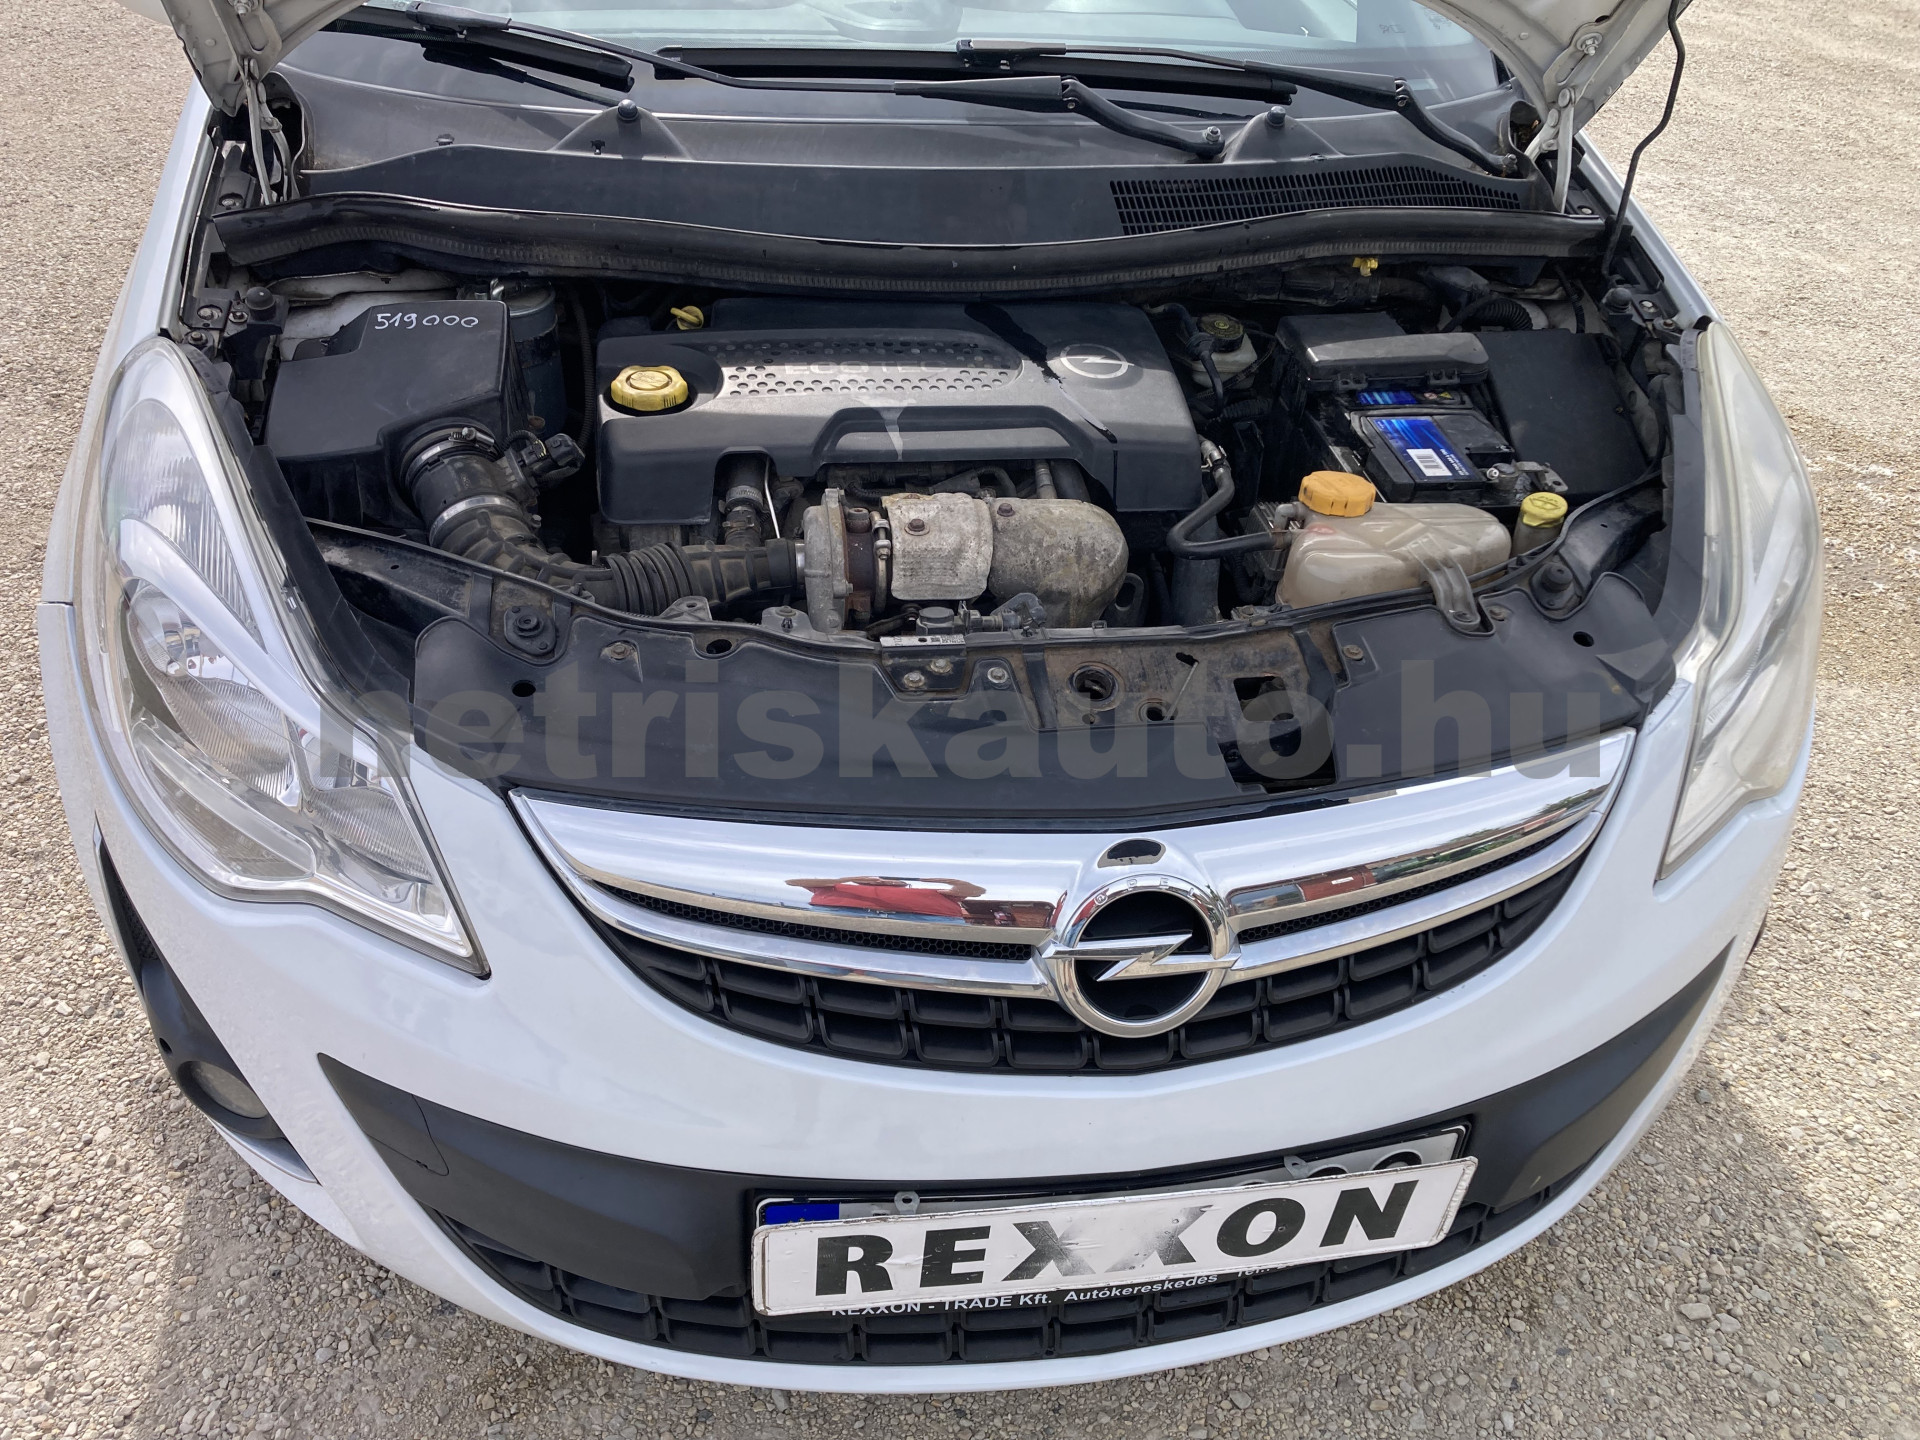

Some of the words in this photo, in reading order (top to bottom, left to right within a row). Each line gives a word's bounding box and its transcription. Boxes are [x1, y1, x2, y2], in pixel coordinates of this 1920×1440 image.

[375, 312, 479, 330] 519000
[784, 361, 948, 375] ECOTEC
[815, 1179, 1419, 1297] REXXON
[938, 1295, 1013, 1311] TRADE
[1018, 1293, 1052, 1306] Kft.
